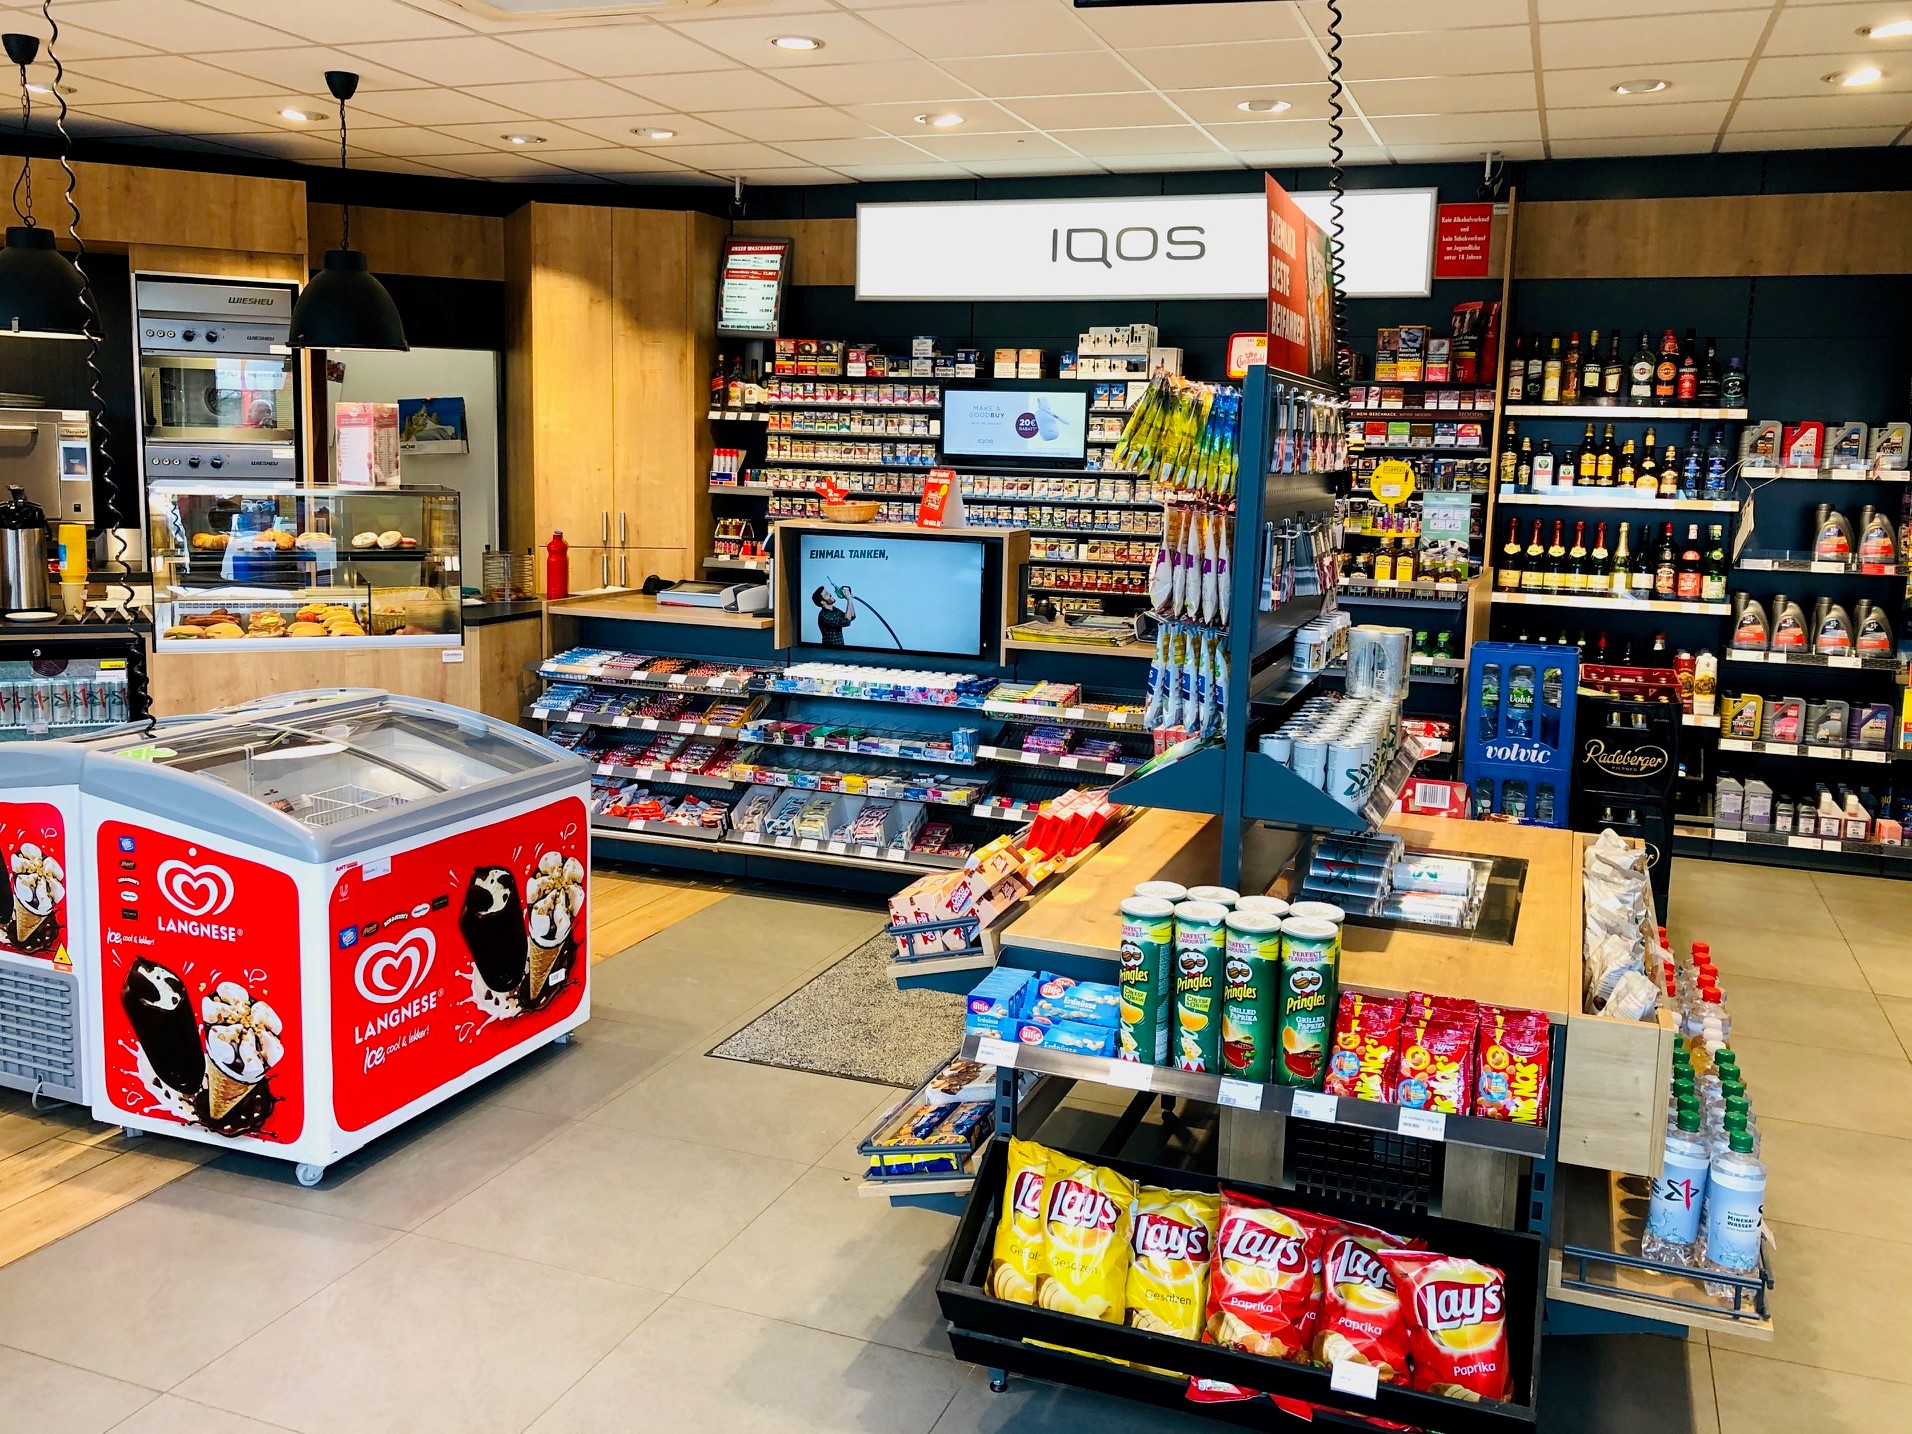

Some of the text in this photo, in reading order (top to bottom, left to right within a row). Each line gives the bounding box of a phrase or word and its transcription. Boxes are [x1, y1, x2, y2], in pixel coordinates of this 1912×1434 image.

[1270, 210, 1296, 260] ZIEMLICH
[1052, 226, 1206, 269] IQOS
[1271, 255, 1290, 297] BESTE
[228, 297, 274, 306] WIESHEU
[1019, 418, 1037, 427] 20€
[809, 549, 889, 560] EINMAL TANKEN,
[1509, 695, 1534, 704] Volvic
[1485, 742, 1552, 765] volvic
[1583, 739, 1665, 772] Radeberger
[1043, 984, 1062, 995] ültje
[1177, 974, 1213, 994] Pringles
[1224, 984, 1257, 1002] Pringles
[973, 1002, 990, 1012] ültje
[1063, 997, 1097, 1009] Erdnüsse
[1228, 1005, 1257, 1015] GRILLED
[1286, 993, 1326, 1016] Pringles
[977, 1016, 999, 1024] Erdnüsse
[1230, 1012, 1258, 1021] PAPRIKA
[386, 1039, 401, 1055] cool
[401, 1036, 407, 1048] &
[408, 1024, 430, 1044] lekker!
[1021, 1029, 1041, 1040] ültje
[1132, 1214, 1206, 1260] Lay's
[1221, 1219, 1300, 1274] Lay's
[1051, 1257, 1098, 1275] Gesalzen
[1144, 1288, 1192, 1306] Gesalzen
[1230, 1296, 1274, 1313] Paprika
[1425, 1280, 1502, 1331] Lay's
[1337, 1316, 1382, 1336] Paprika
[1453, 1361, 1497, 1377] Paprika
